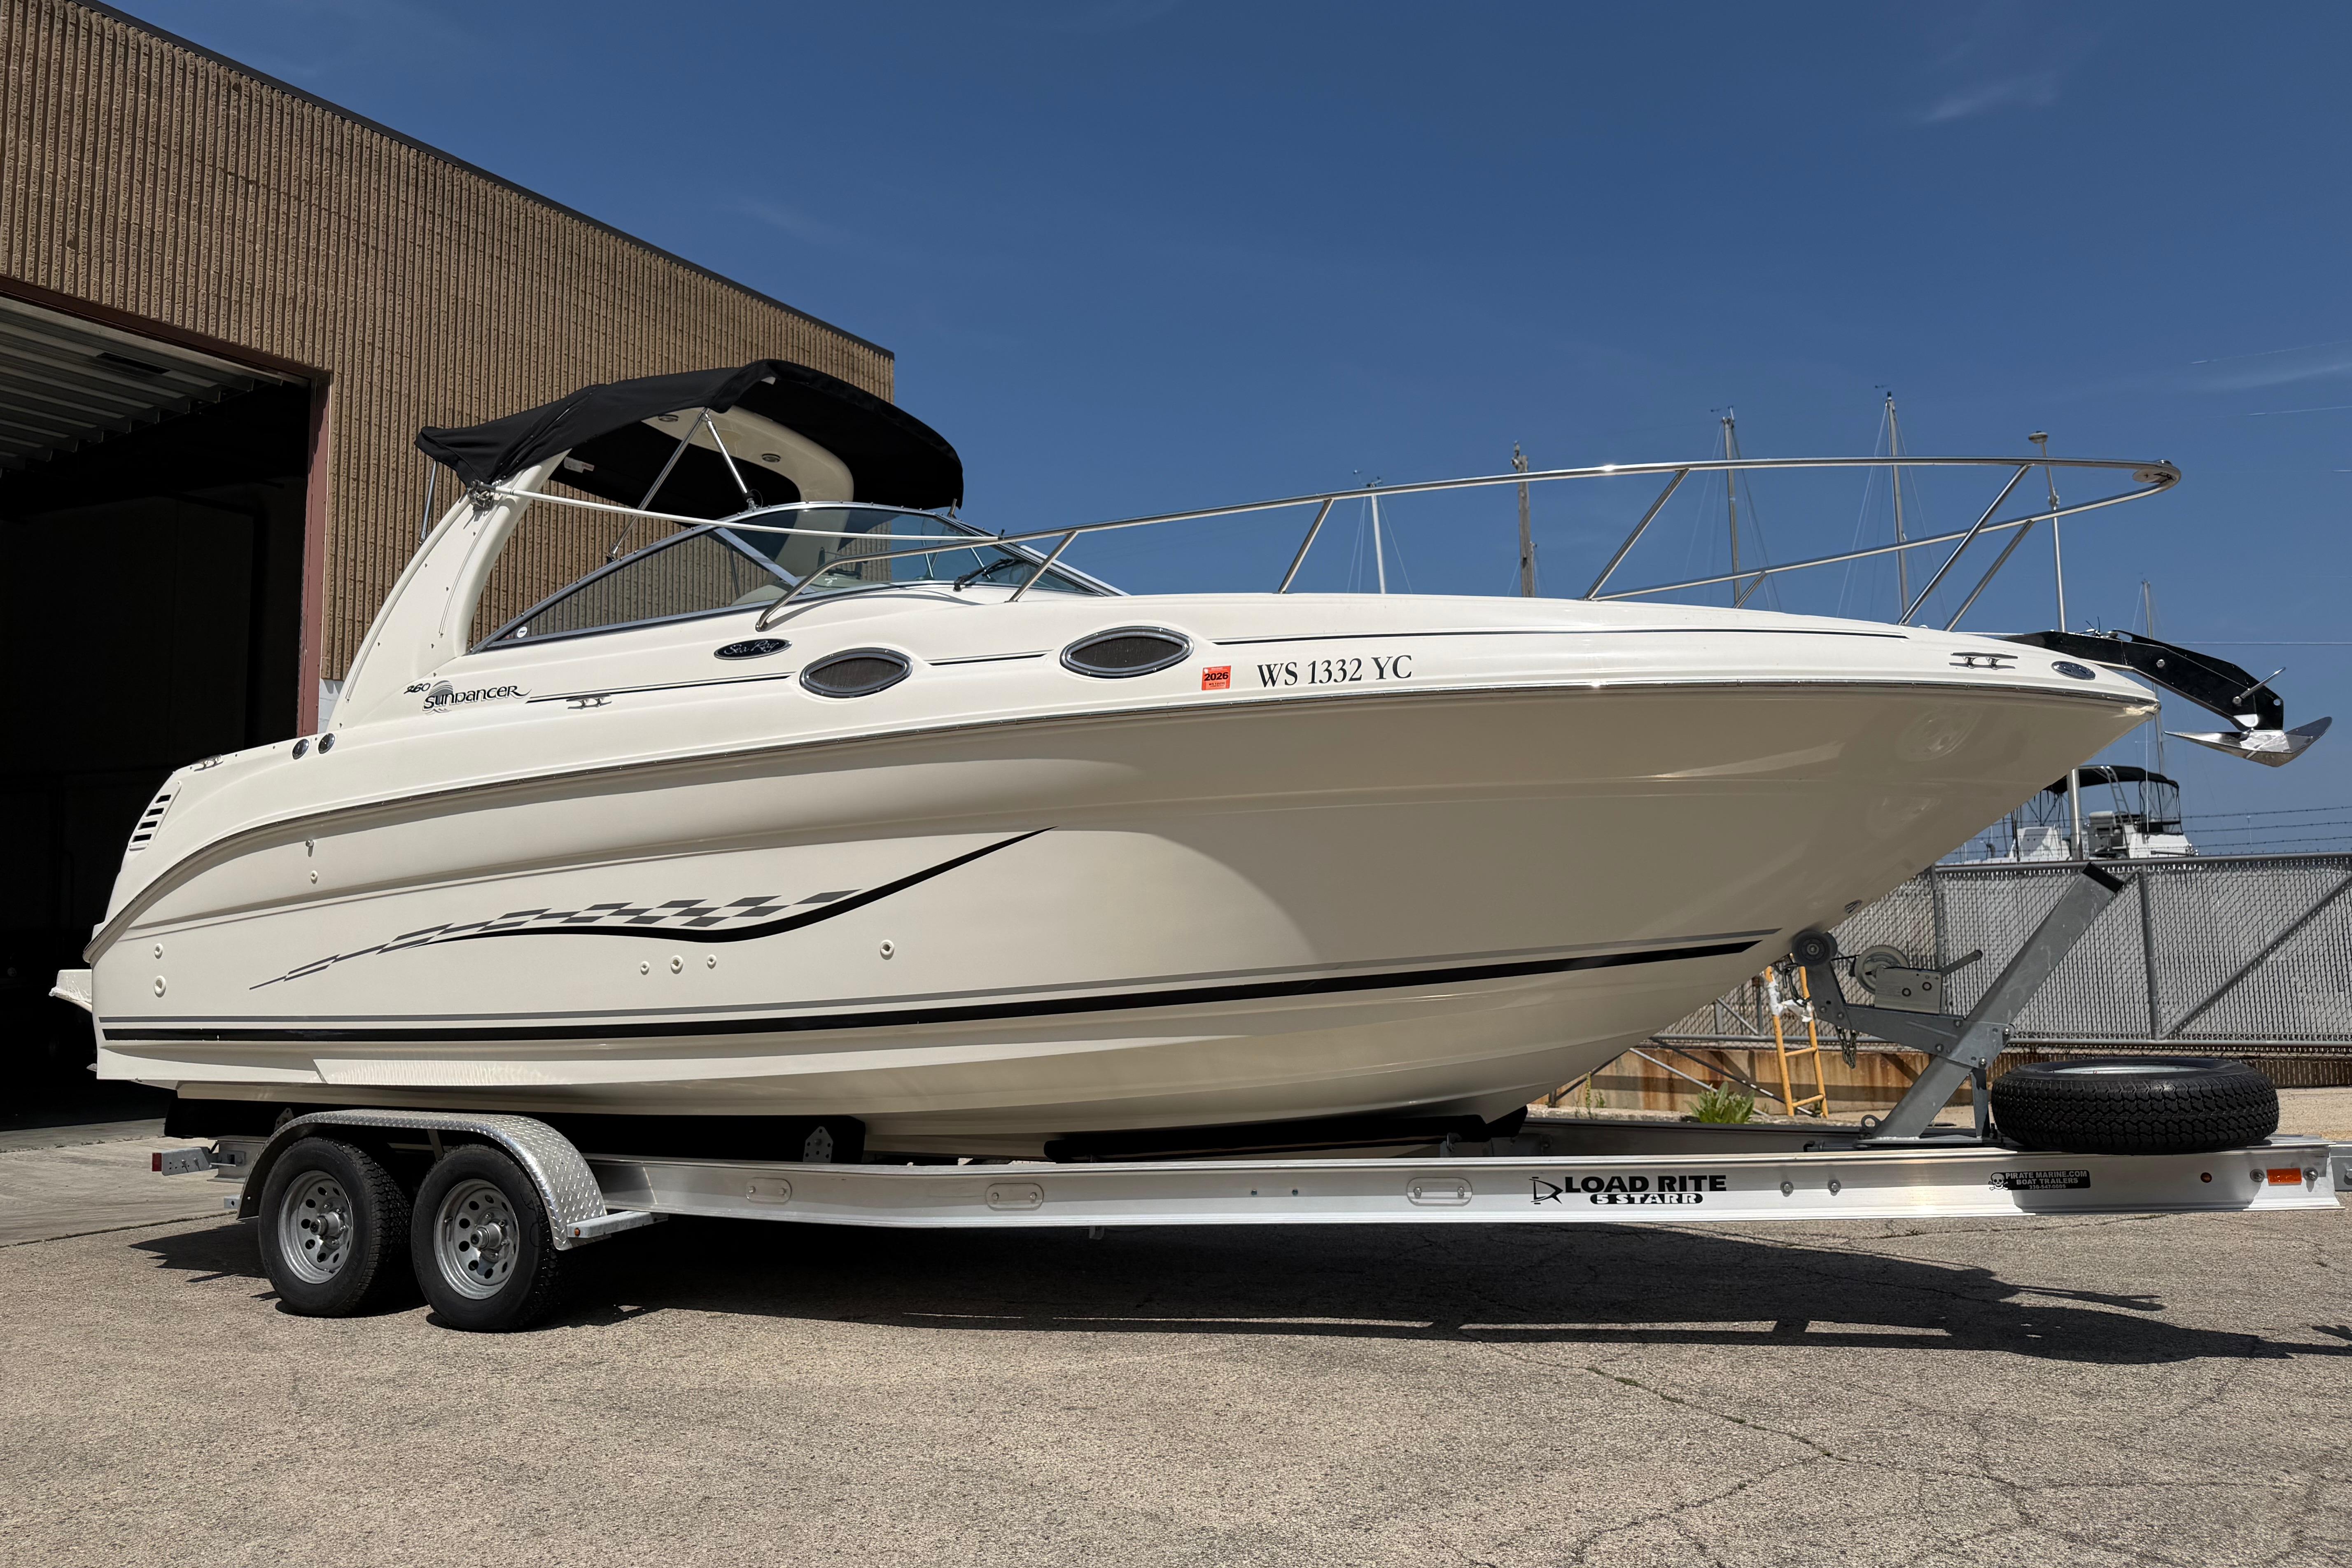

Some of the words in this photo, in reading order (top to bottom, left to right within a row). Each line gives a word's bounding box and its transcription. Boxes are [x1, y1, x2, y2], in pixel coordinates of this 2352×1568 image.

[723, 644, 749, 655] Sea
[750, 640, 779, 653] Ray
[1204, 671, 1229, 681] 2026
[1257, 661, 1298, 688] WS
[1307, 658, 1362, 684] 1332
[1370, 655, 1412, 680] YC
[404, 683, 431, 694] 260
[1565, 1176, 1649, 1193] LOAD
[1657, 1175, 1727, 1192] RITE
[1596, 1194, 1610, 1203] 5
[1616, 1193, 1697, 1204] STARR
